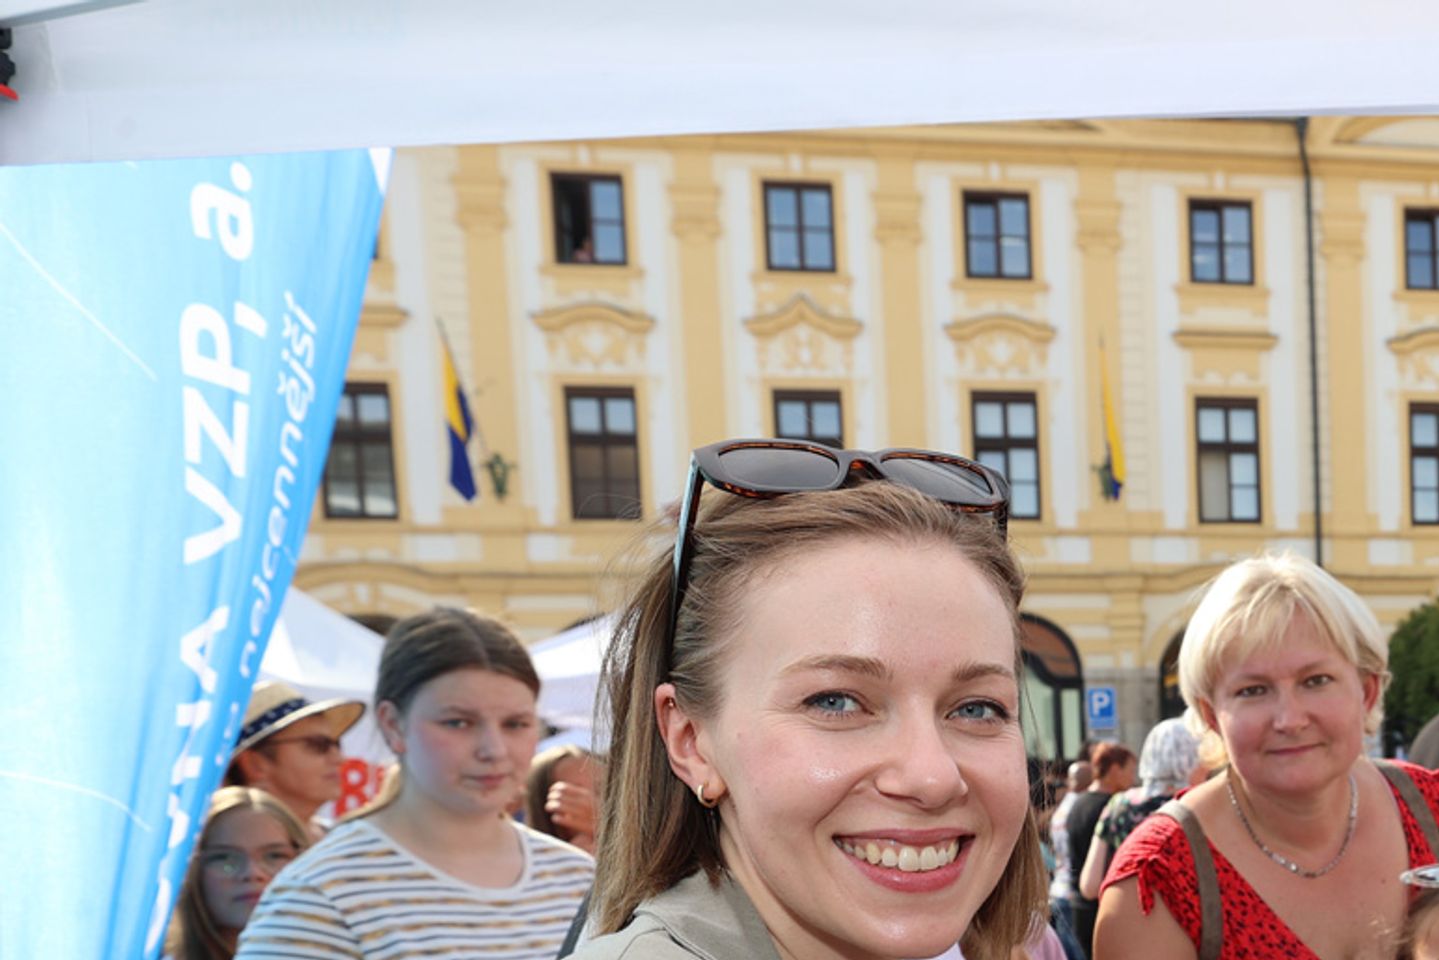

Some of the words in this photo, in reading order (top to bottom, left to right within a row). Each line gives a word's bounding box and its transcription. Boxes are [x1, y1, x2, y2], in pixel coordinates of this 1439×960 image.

[189, 160, 254, 262] a.
[177, 300, 269, 564] VZP,
[239, 288, 318, 680] nejcennější
[1091, 692, 1111, 716] P
